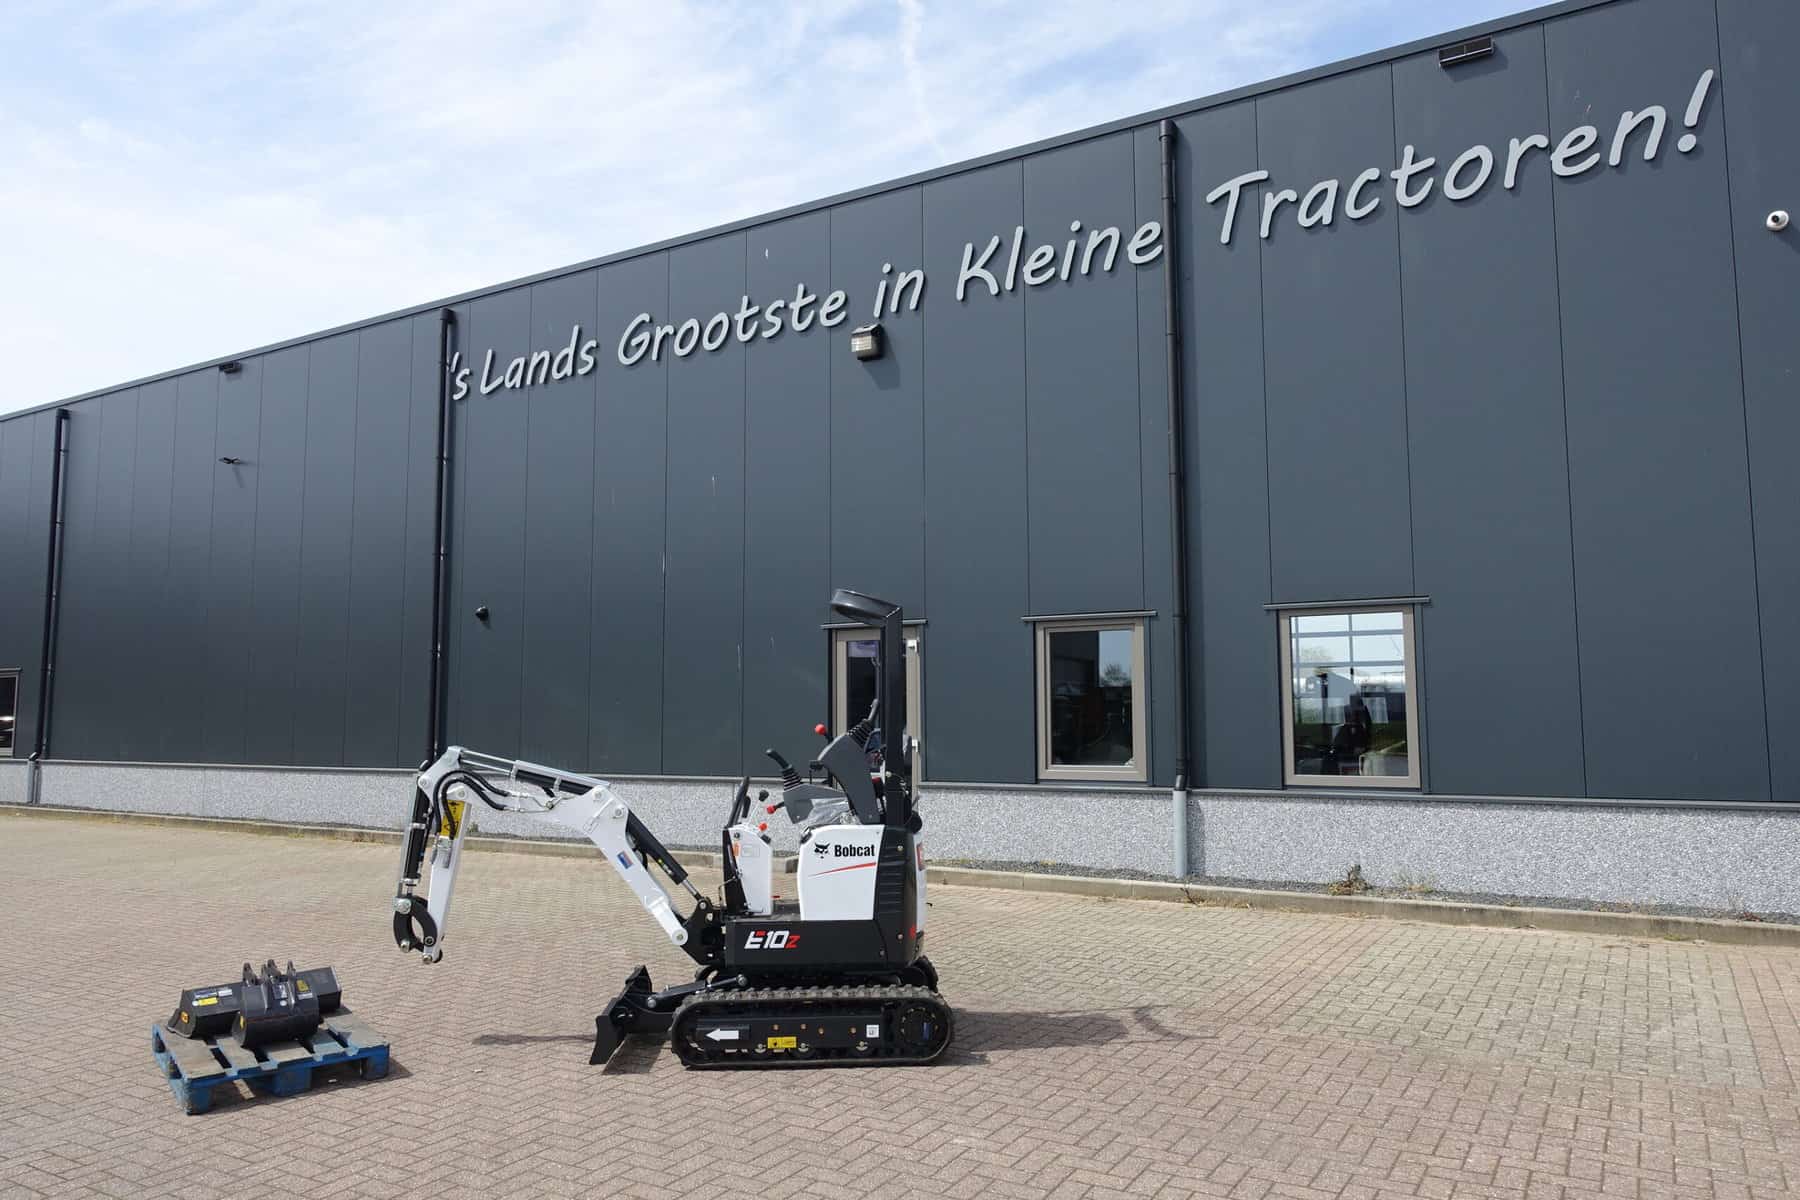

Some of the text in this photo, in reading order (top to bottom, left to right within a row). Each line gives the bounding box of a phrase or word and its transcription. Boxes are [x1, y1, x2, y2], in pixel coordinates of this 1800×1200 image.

[479, 324, 598, 395] Lands
[617, 283, 848, 366] Grootste
[872, 262, 925, 319] in
[955, 220, 1163, 301] Kleine
[1206, 69, 1714, 244] Tractoren!
[834, 844, 875, 858] Bobcat
